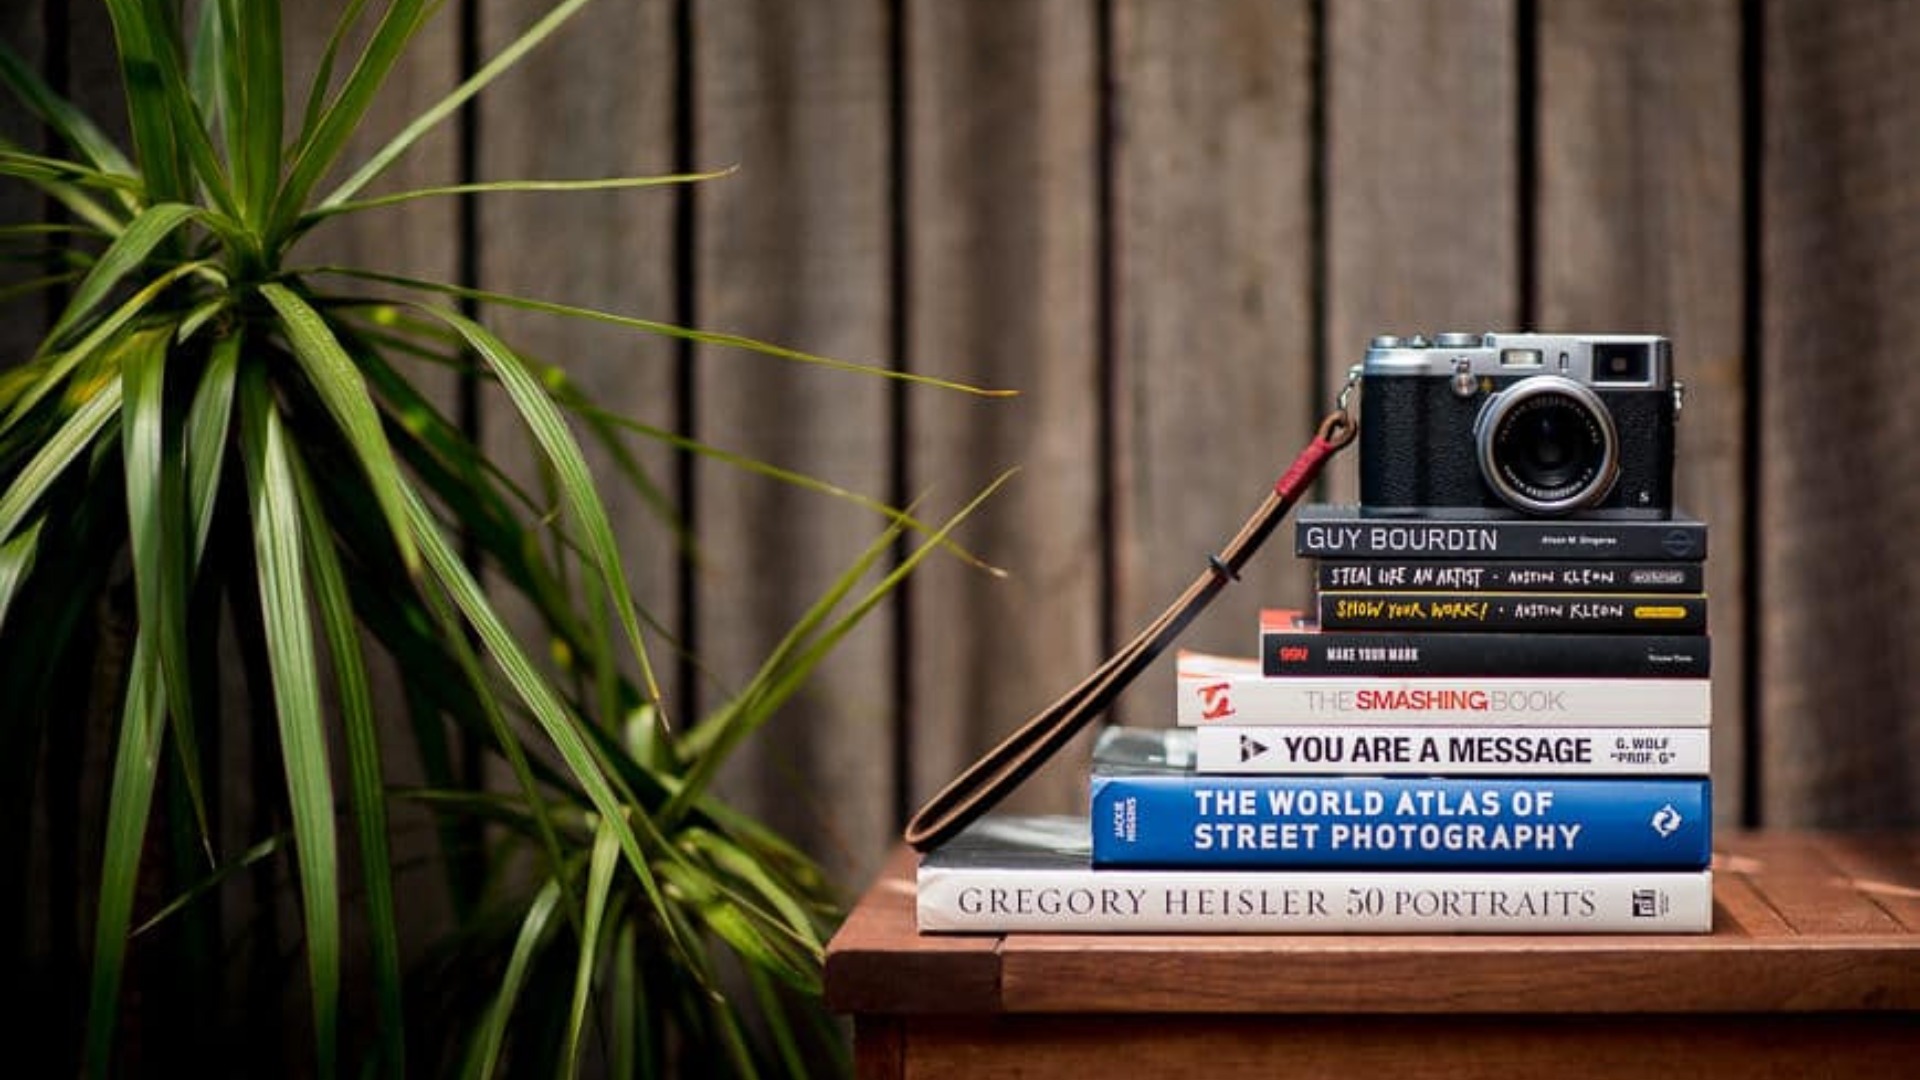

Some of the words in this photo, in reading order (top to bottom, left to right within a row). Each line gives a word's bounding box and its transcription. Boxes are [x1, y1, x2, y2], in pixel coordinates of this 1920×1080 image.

[1306, 528, 1361, 550] GUY
[1371, 528, 1498, 551] BOURDIN
[1331, 567, 1372, 586] STEAL
[1378, 567, 1406, 585] LIKE
[1413, 568, 1432, 585] AN
[1436, 569, 1484, 588] ARTIST
[1564, 570, 1614, 584] KLEON
[1337, 600, 1384, 619] SHOW
[1388, 603, 1427, 619] YOUR
[1431, 602, 1488, 621] WORK!
[1570, 604, 1623, 618] KLEON
[1327, 647, 1355, 661] MAKE
[1358, 648, 1386, 661] YOUR
[1389, 648, 1418, 661] MARK
[1304, 690, 1353, 711] THE
[1355, 690, 1489, 711] SMASHING
[1490, 691, 1566, 711] BOOK
[1283, 736, 1345, 763] YOU
[1352, 737, 1412, 763] ARE
[1419, 737, 1440, 763] A
[1448, 738, 1592, 763] MESSAGE
[1195, 790, 1257, 815] THE
[1267, 790, 1384, 815] WORLD
[1395, 790, 1500, 816] ATLAS
[1511, 790, 1554, 816] OF
[1194, 824, 1319, 849] STREET
[1331, 824, 1581, 850] PHOTOGRAPHY
[958, 888, 1148, 916] GREGORY
[1164, 888, 1328, 916] HEISLER
[1347, 888, 1384, 916] 50
[1395, 888, 1596, 916] PORTRAITS
